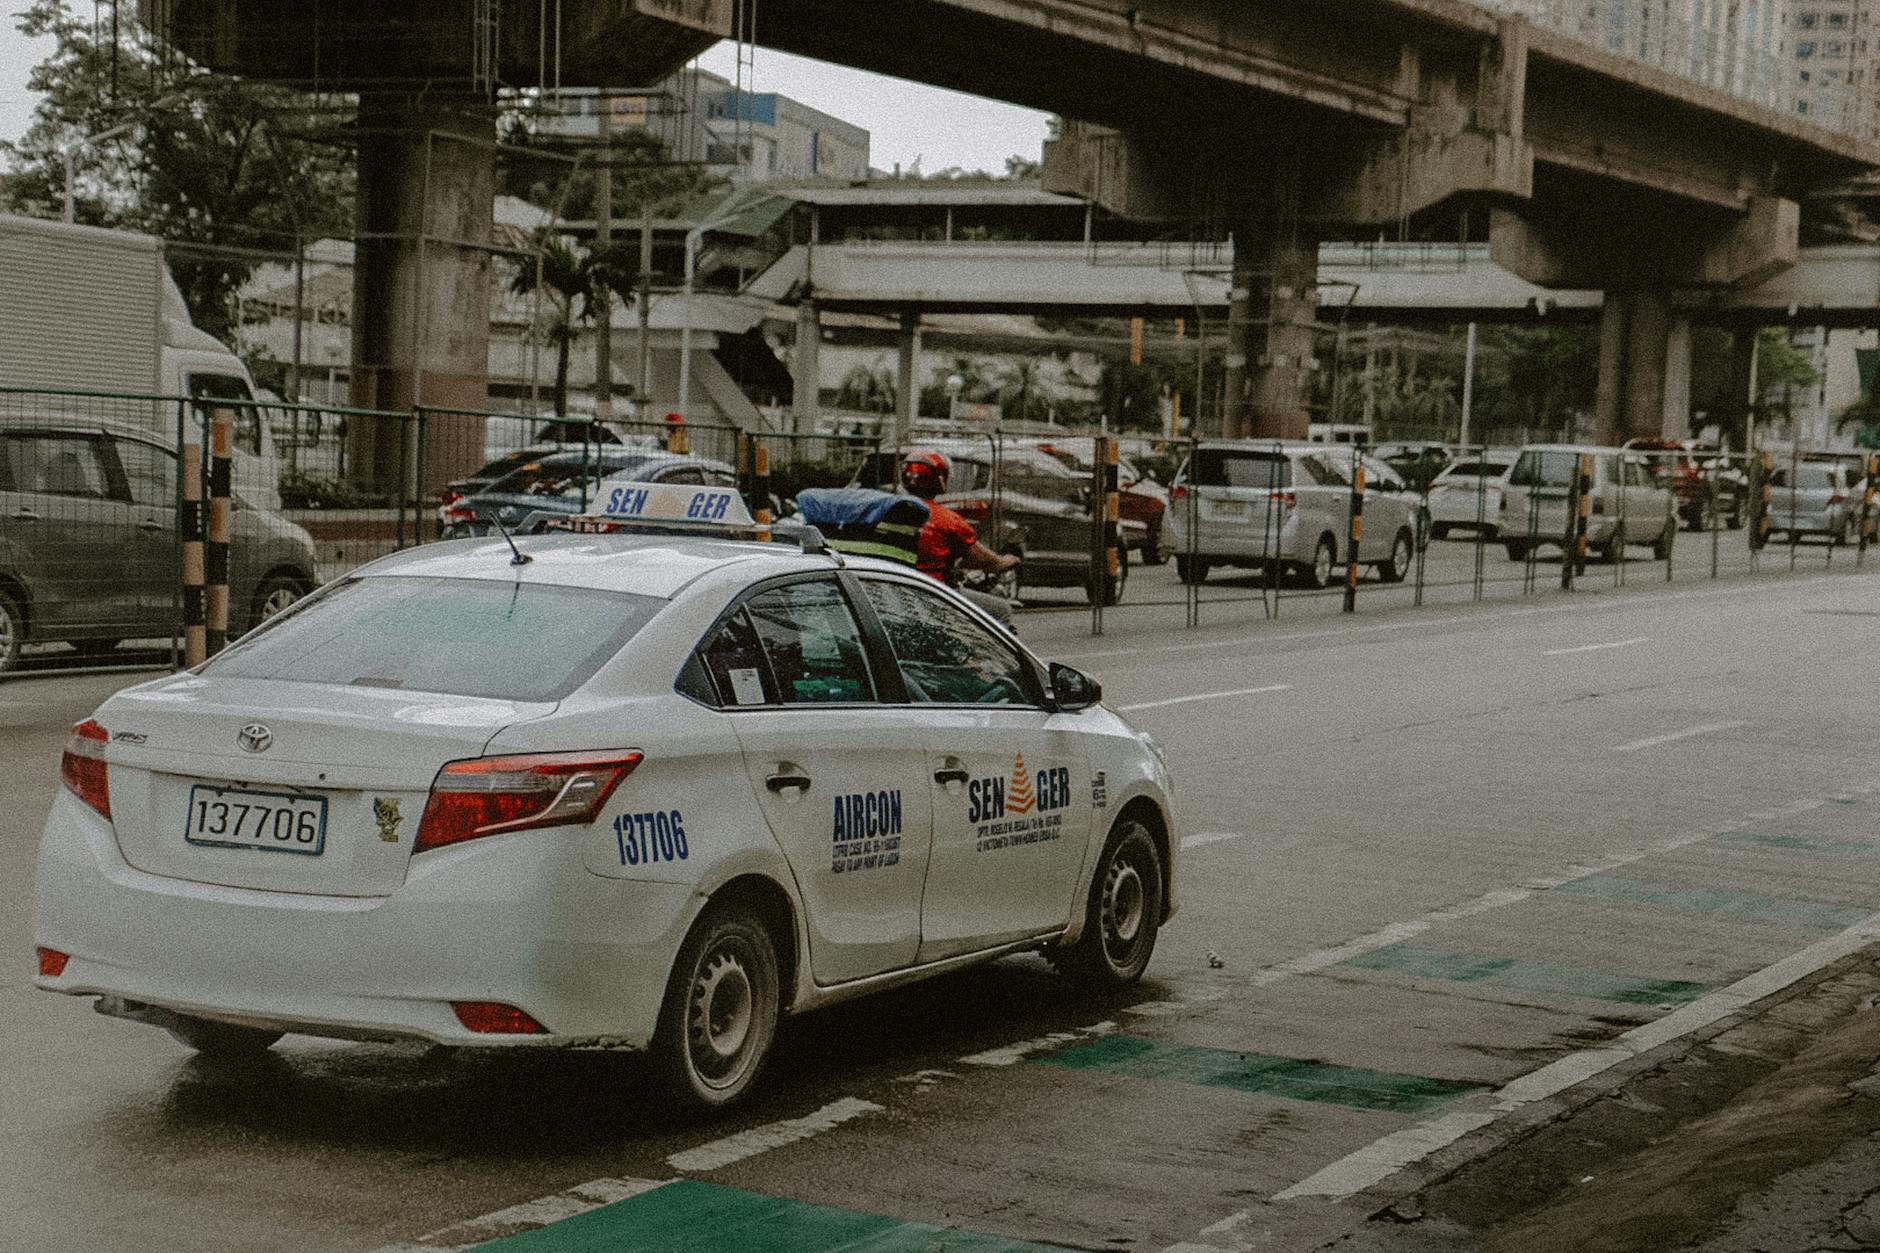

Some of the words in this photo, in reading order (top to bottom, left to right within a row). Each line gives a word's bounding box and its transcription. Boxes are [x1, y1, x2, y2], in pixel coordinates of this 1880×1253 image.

[607, 488, 649, 514] SEN
[687, 492, 731, 519] GER
[198, 800, 317, 843] 137706
[832, 789, 902, 843] AIRCON
[968, 776, 1005, 824] SEN
[1036, 766, 1071, 813] GER
[612, 809, 689, 866] 137706
